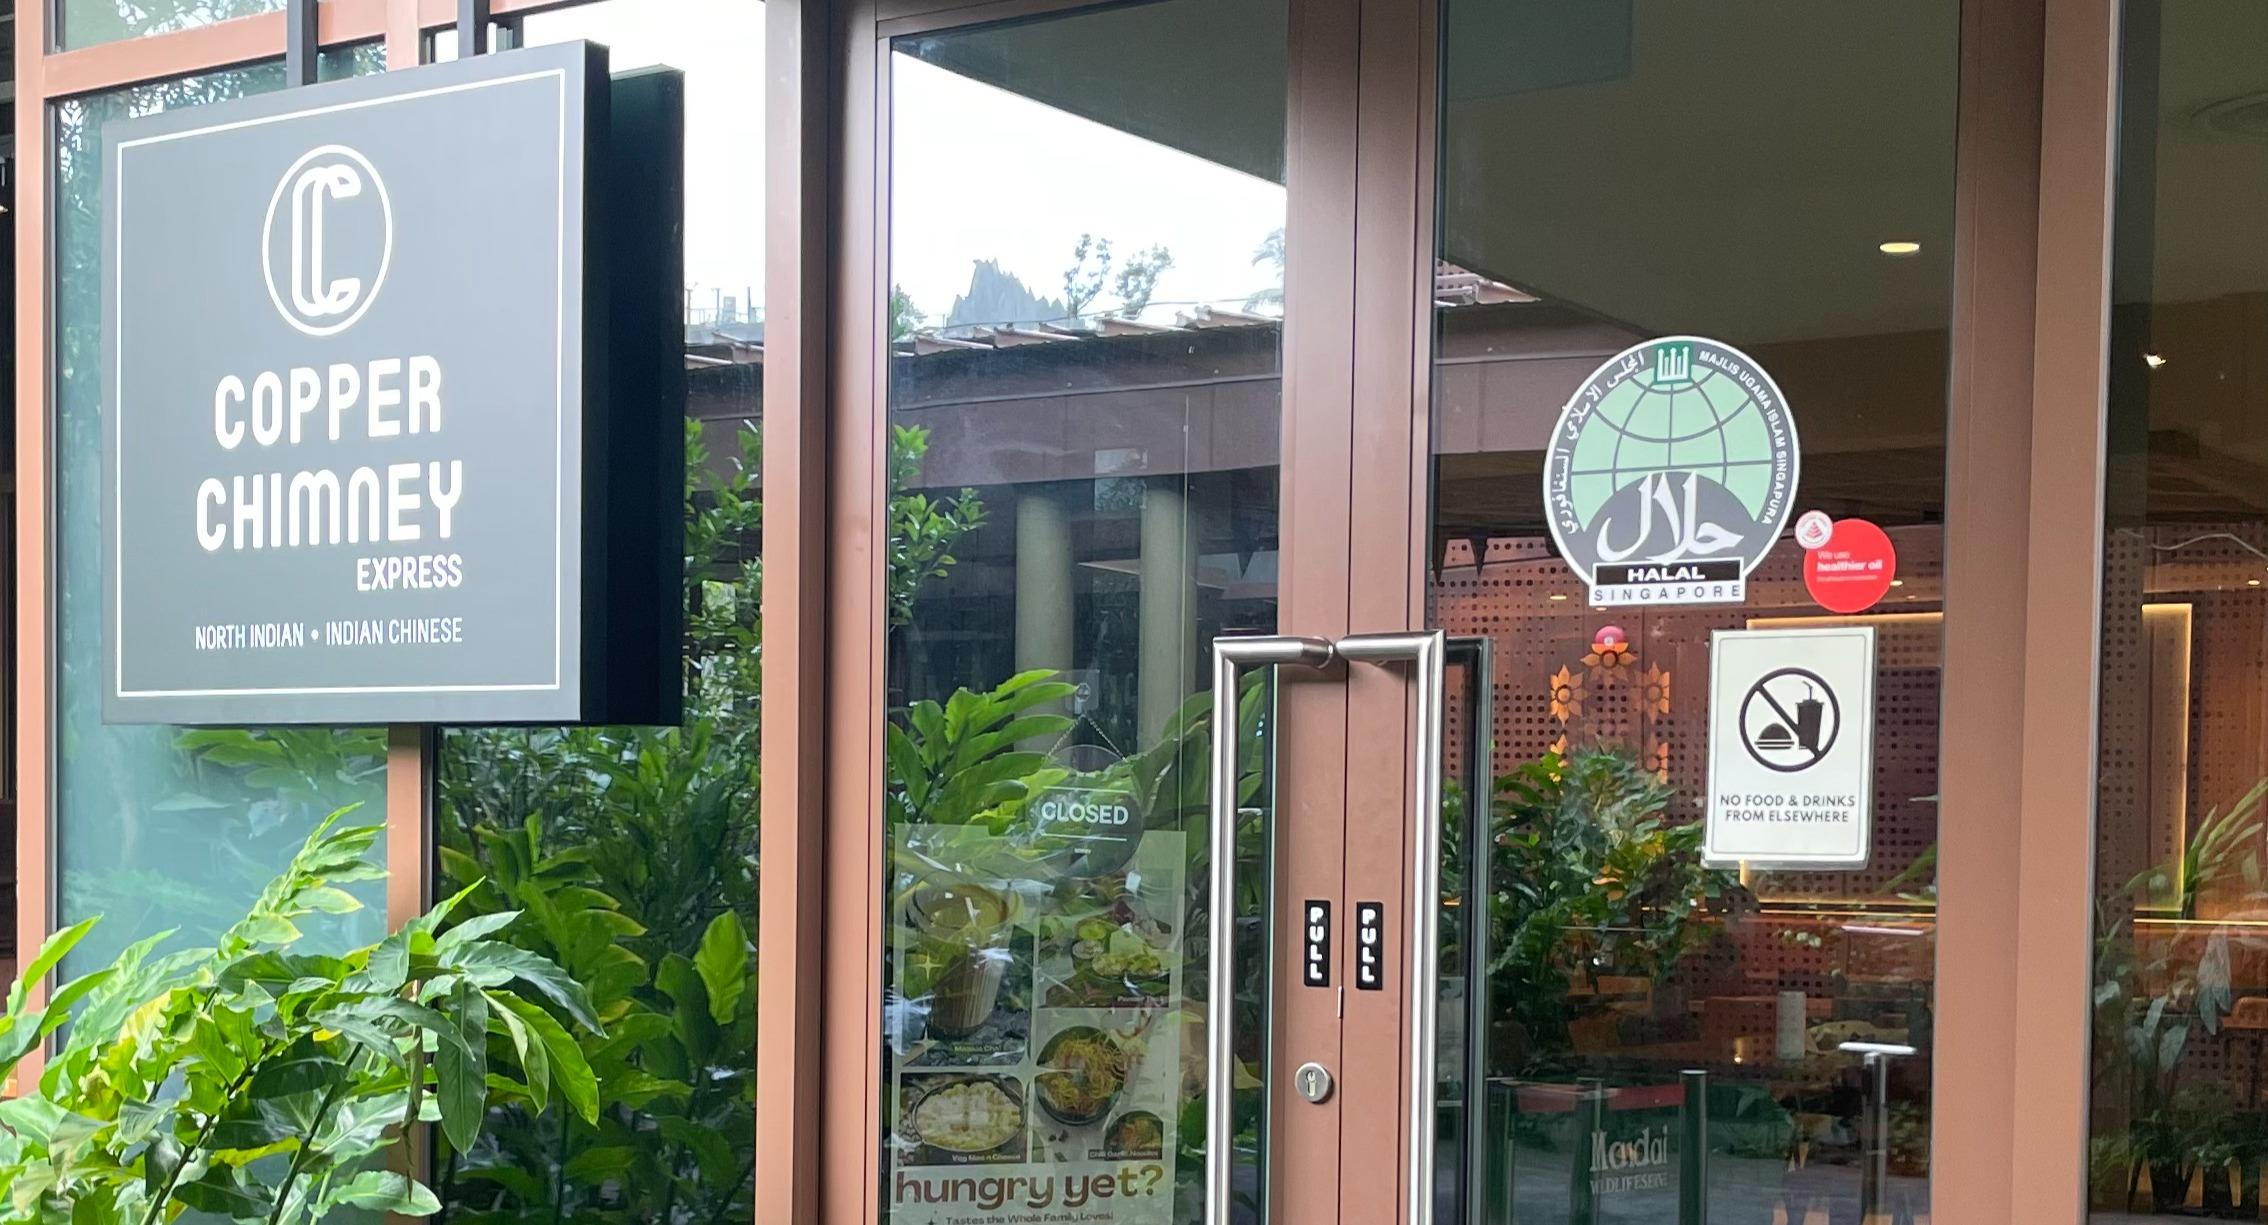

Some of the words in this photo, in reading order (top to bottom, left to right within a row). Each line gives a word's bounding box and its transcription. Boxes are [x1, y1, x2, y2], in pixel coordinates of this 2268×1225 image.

[1699, 350, 1740, 376] MAJLIS
[215, 355, 441, 449] COPPER
[1739, 370, 1772, 410] UGAMA
[1767, 409, 1786, 448] ISLAM
[197, 460, 462, 551] CHIMNEY
[1761, 451, 1788, 525] SINGAPURA
[1597, 470, 1744, 565] حلال
[357, 554, 463, 591] EXPRESS
[1627, 566, 1706, 582] HALAL
[1594, 585, 1741, 601] SINGAPORE
[195, 624, 246, 650] NORTH
[250, 622, 304, 648] INDIAN
[326, 619, 383, 646] INDIAN
[388, 617, 463, 644] CHINESE
[1041, 801, 1129, 825] CLOSED
[1720, 795, 1741, 806] NO
[1745, 795, 1784, 806] FOOD
[1788, 795, 1798, 806] &
[1803, 795, 1855, 806] DRINKS
[1725, 811, 1765, 822] FROM
[1769, 811, 1849, 822] ELSEWHERE
[1309, 907, 1325, 979] PULL
[1361, 908, 1377, 982] PULL
[896, 1171, 1054, 1210] hungry
[1063, 1164, 1164, 1206] yet?
[946, 1216, 985, 1225] Tastes
[987, 1216, 1005, 1224] the
